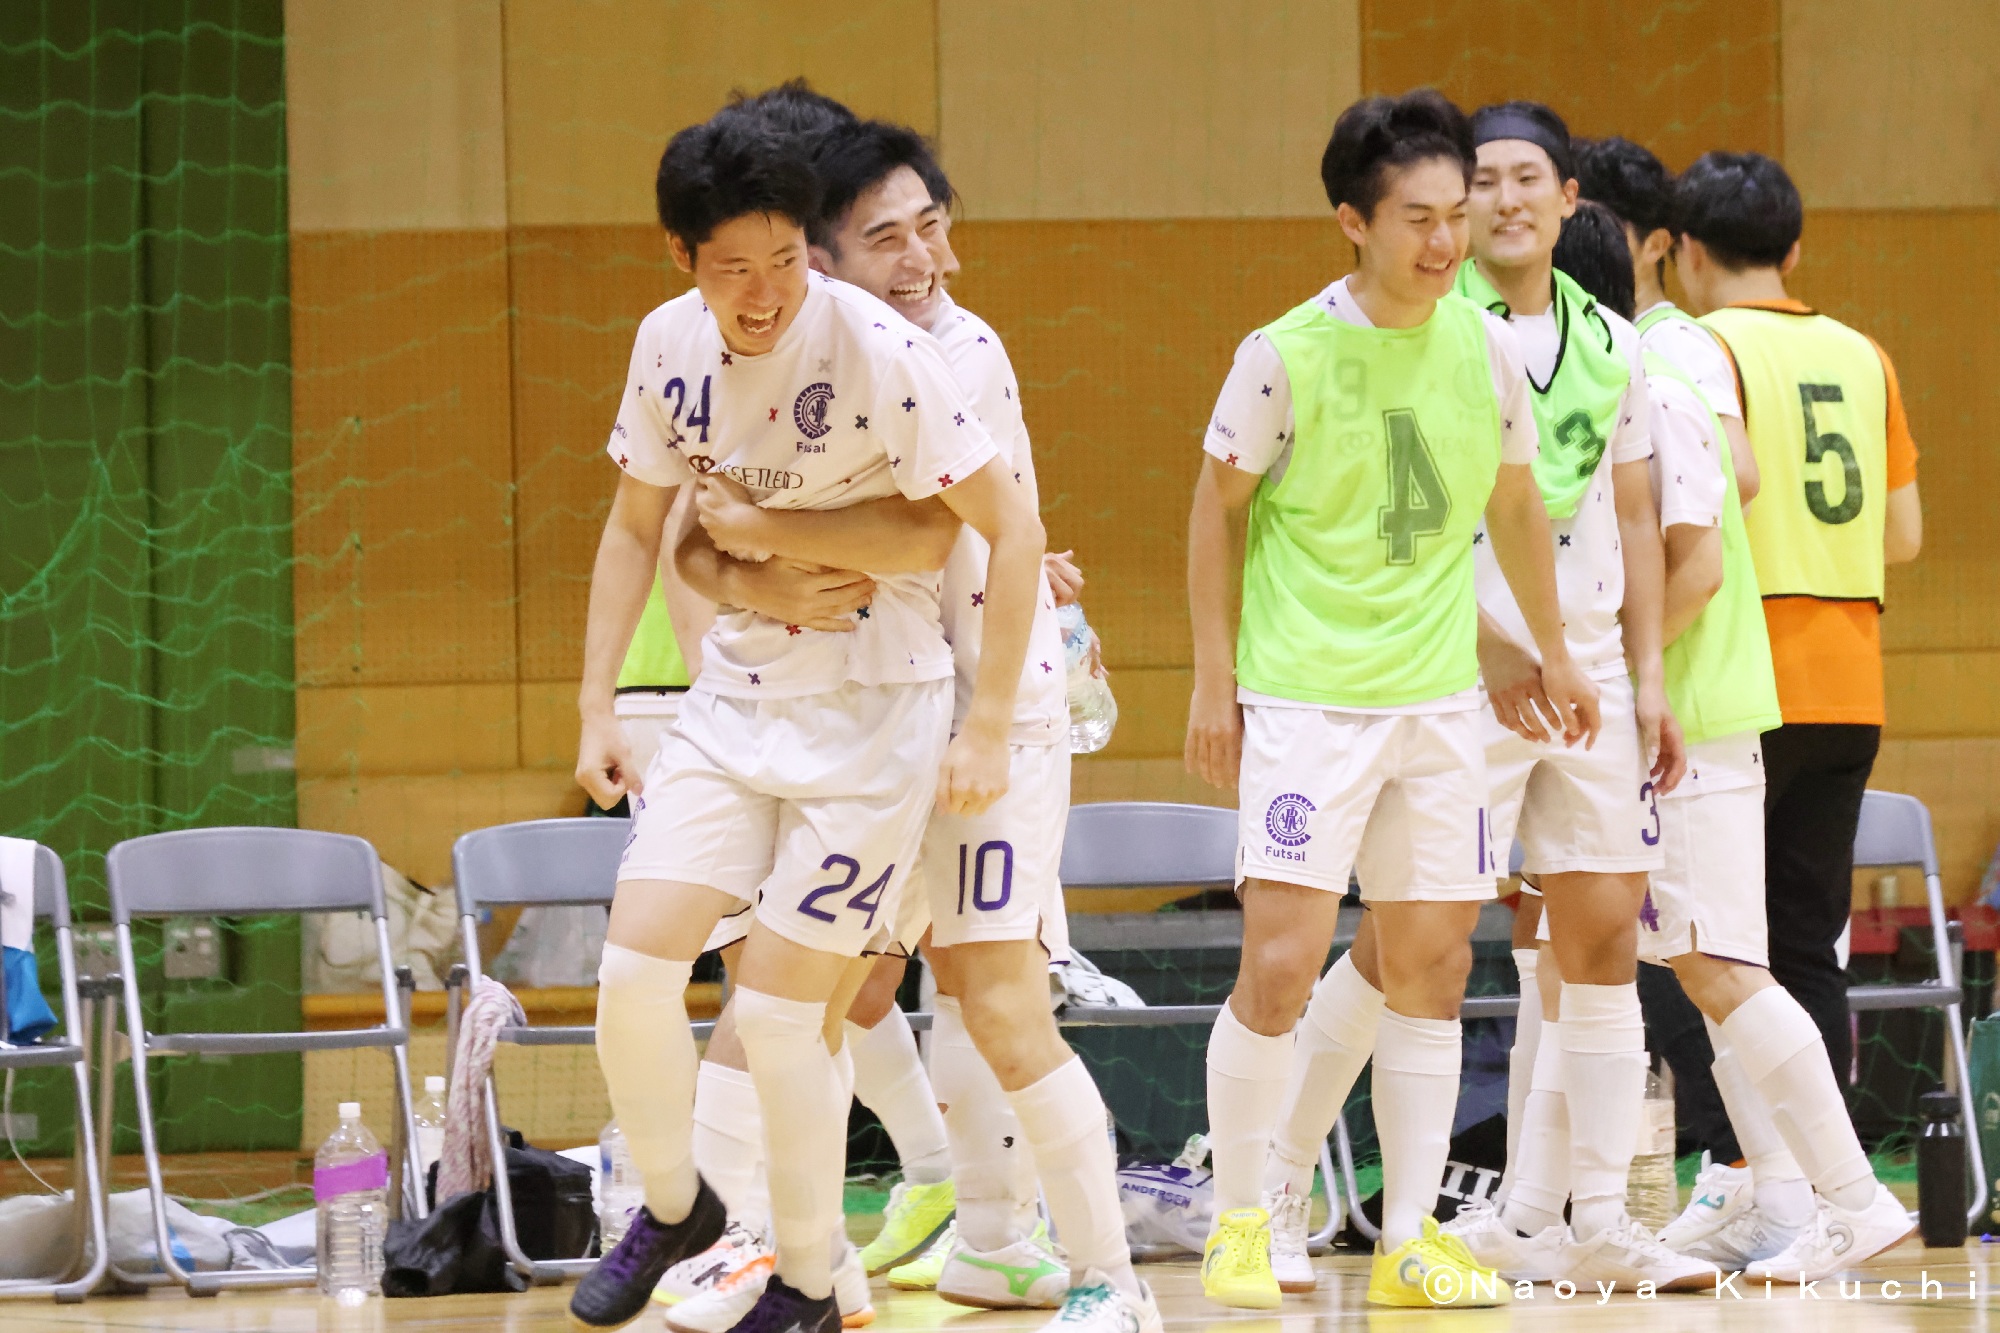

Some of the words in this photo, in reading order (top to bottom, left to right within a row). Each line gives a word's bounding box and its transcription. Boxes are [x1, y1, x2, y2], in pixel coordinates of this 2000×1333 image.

[663, 375, 712, 443] 24
[1553, 408, 1607, 478] 3
[1378, 407, 1453, 566] 4
[1798, 382, 1863, 525] 5
[1640, 781, 1660, 846] 3
[957, 840, 1014, 915] 10
[1265, 845, 1306, 862] Futsal
[797, 853, 896, 930] 24
